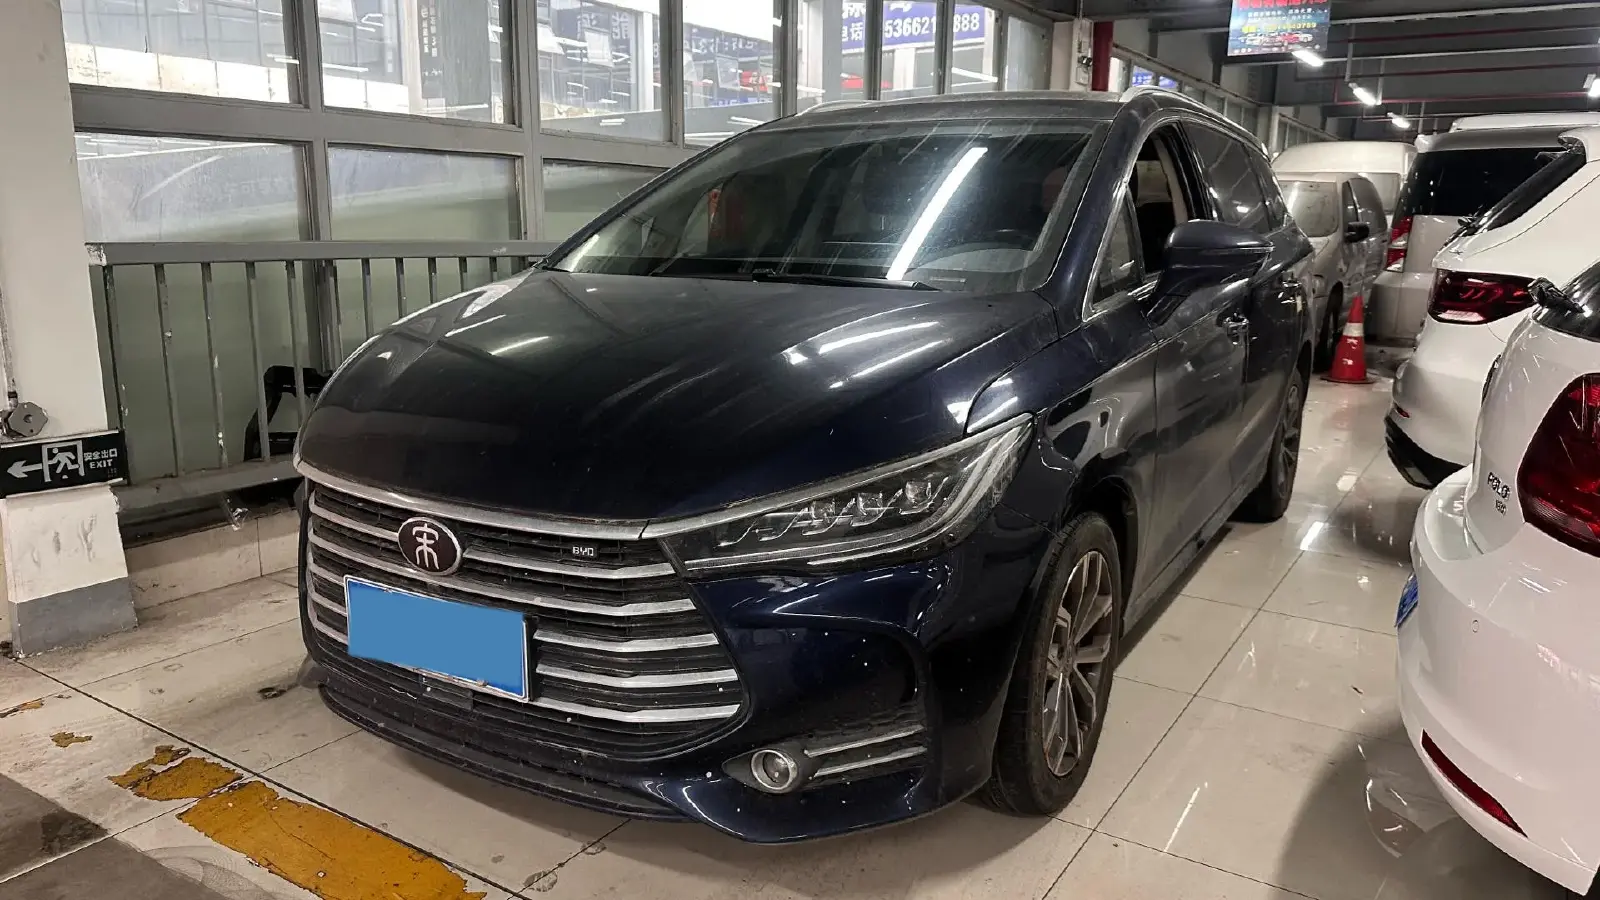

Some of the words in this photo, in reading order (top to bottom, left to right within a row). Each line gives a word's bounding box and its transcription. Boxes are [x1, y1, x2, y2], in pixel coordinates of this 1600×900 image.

[84, 448, 117, 461] 安全出口
[89, 459, 113, 469] EXIT
[1487, 472, 1510, 498] POLO
[572, 546, 594, 557] BYD
